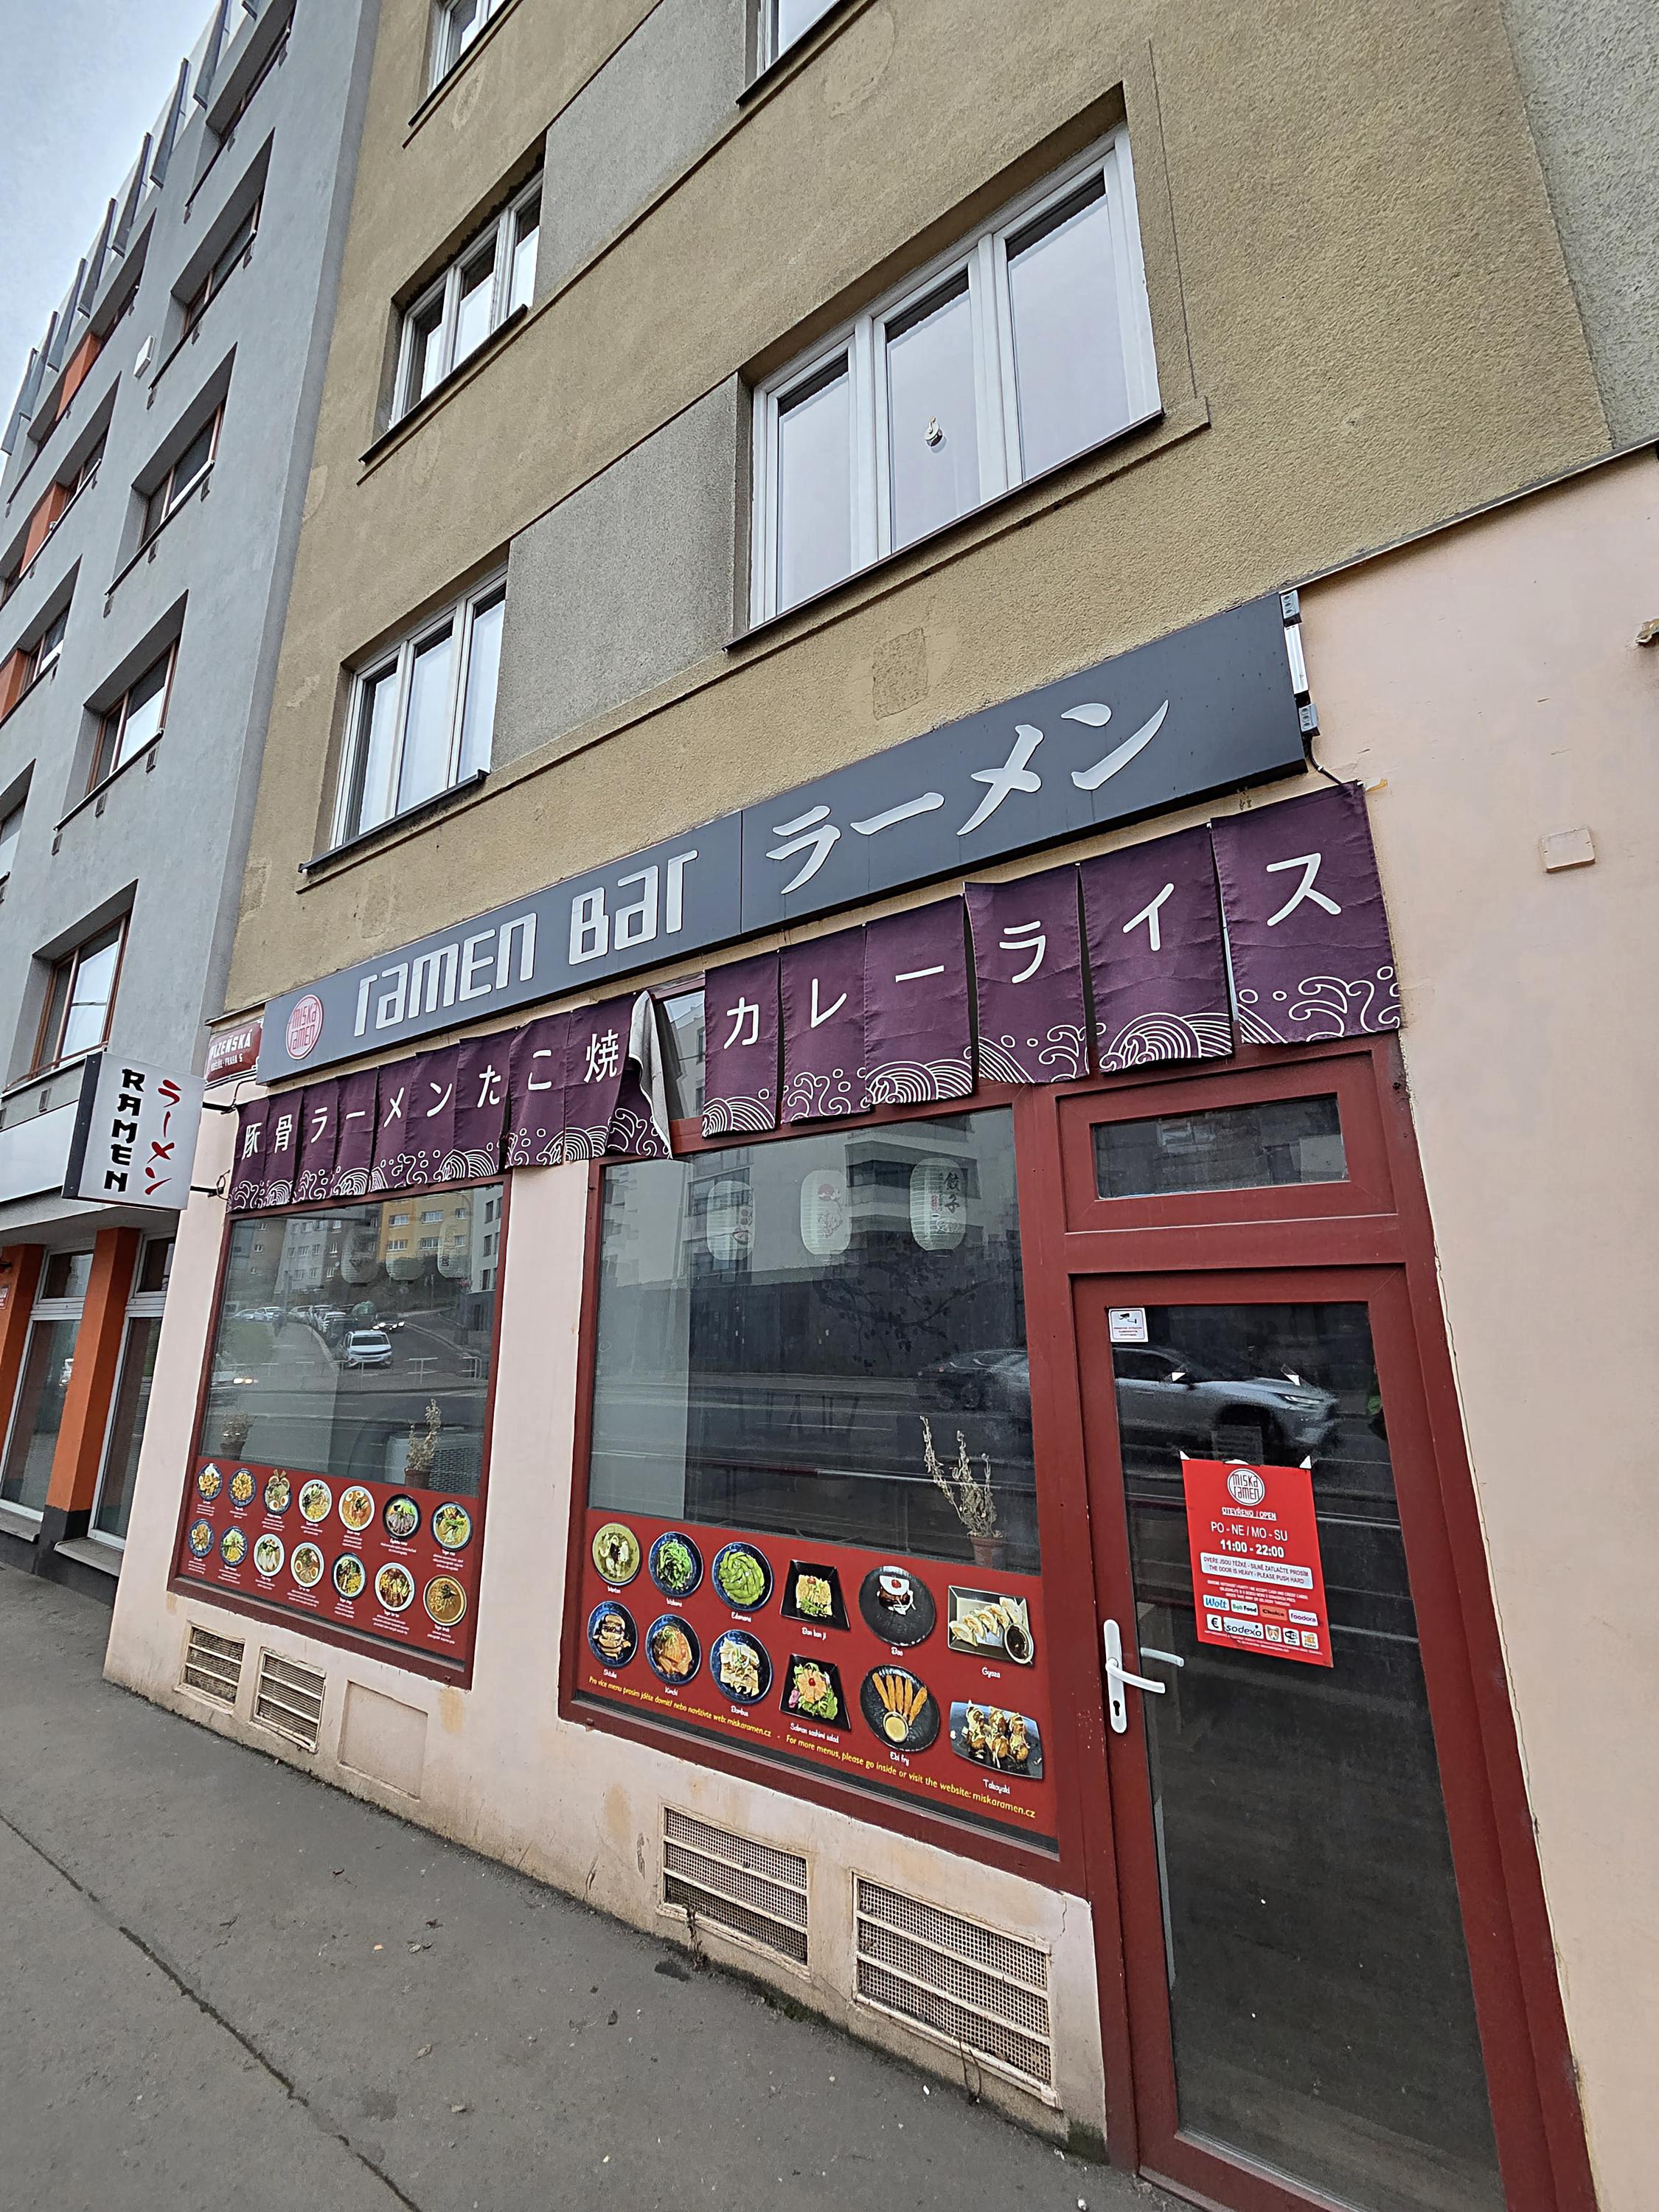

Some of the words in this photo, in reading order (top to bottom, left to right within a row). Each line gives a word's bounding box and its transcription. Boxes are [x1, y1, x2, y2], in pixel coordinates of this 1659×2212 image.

[765, 698, 1170, 895] ラーメン
[723, 850, 1343, 1050] カレーライス
[104, 1068, 145, 1192] RAMEN
[145, 1079, 182, 1195] ラーメン
[1259, 1512, 1277, 1520] OPEN
[1211, 1521, 1225, 1533] PO
[1231, 1524, 1245, 1536] NE
[1251, 1526, 1267, 1539] MO
[1274, 1529, 1288, 1542] SU
[1220, 1539, 1248, 1553] 11:00
[1256, 1543, 1284, 1558] 22:00
[1205, 1597, 1228, 1609] Wolt
[1243, 1605, 1257, 1613] Food
[1262, 1609, 1285, 1617] Choice
[1290, 1612, 1316, 1623] foodora
[1225, 1624, 1262, 1637] sodexo
[981, 1666, 1001, 1678] Gyoza
[727, 1719, 772, 1738] miskaramen.cz
[786, 1734, 797, 1745] For
[798, 1739, 815, 1750] more
[816, 1745, 841, 1760] menus,
[841, 1752, 864, 1766] please
[865, 1760, 874, 1770] go
[876, 1762, 897, 1775] inside
[899, 1770, 907, 1778] or
[908, 1773, 923, 1784] visit
[925, 1777, 938, 1788] the
[939, 1782, 972, 1799] website:
[972, 1792, 1037, 1818] miskaramen.cz
